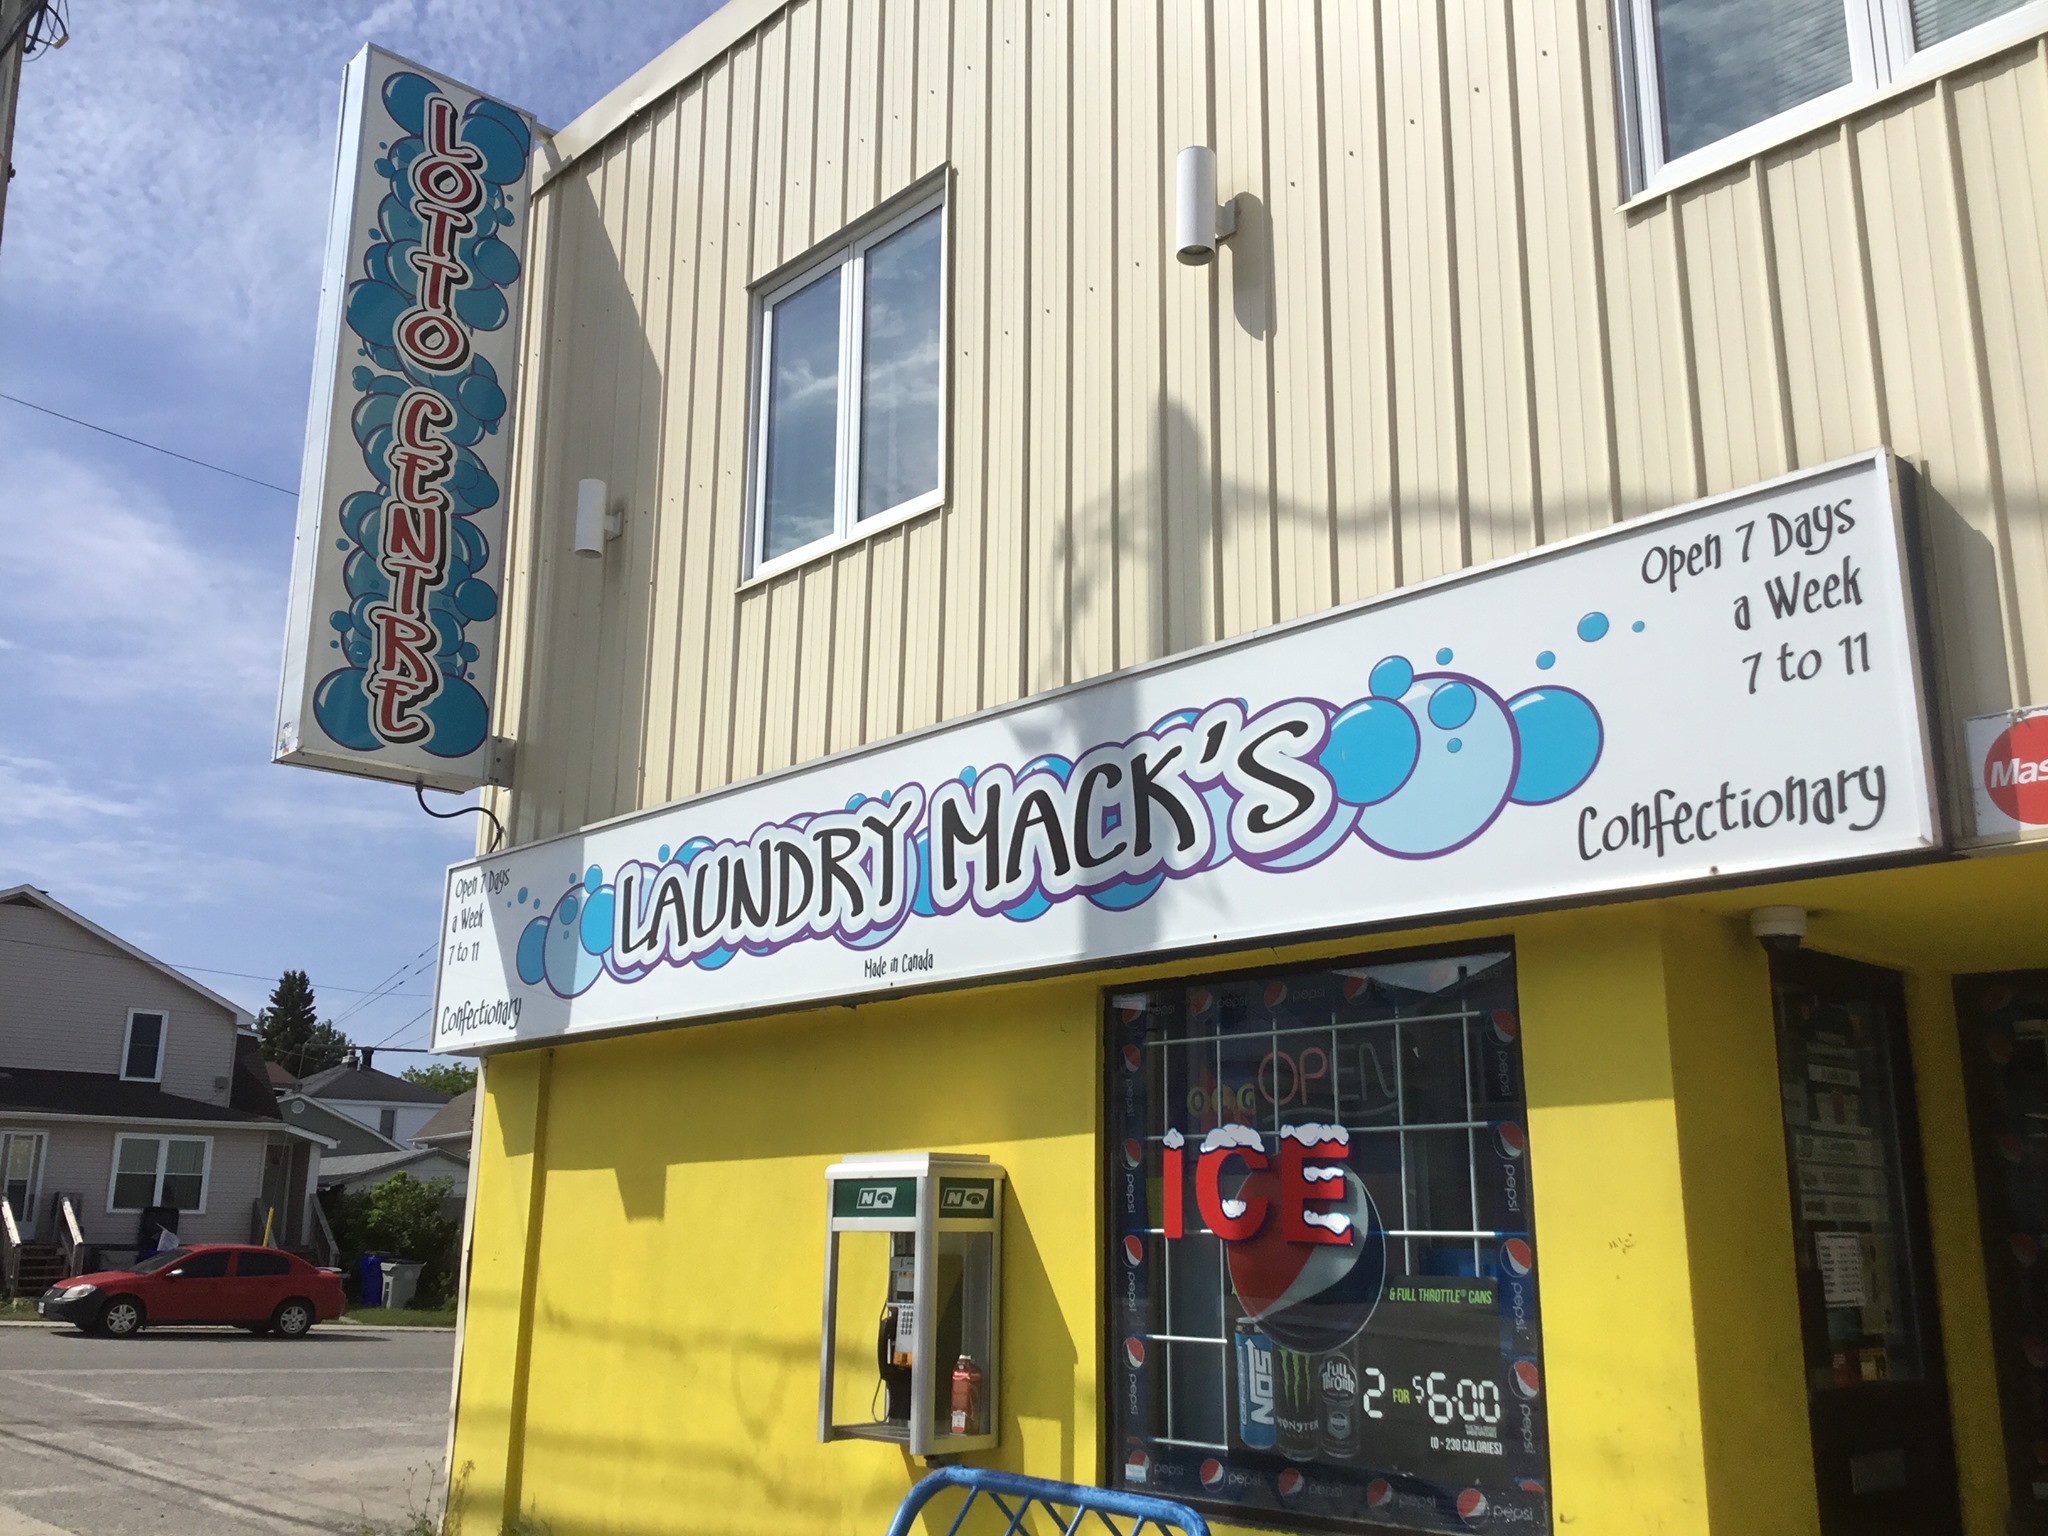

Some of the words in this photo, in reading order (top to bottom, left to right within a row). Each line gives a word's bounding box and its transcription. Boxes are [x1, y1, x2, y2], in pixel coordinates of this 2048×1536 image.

[401, 99, 481, 366] LOTTO
[371, 394, 452, 738] CENTRE
[1641, 533, 1722, 593] Open
[1735, 520, 1756, 563] 7
[1768, 498, 1856, 556] Days
[1734, 596, 1751, 631] a
[1764, 555, 1863, 620] Week
[1742, 652, 1762, 695] 7
[1777, 642, 1822, 683] to
[1838, 632, 1870, 676] 11
[622, 801, 912, 954] LAUNDRY
[942, 720, 1315, 892] MACK'S
[1578, 765, 1886, 861] Confectionary
[455, 876, 477, 903] Open
[480, 873, 487, 893] 7
[488, 868, 510, 895] Days
[452, 916, 457, 933] a
[461, 902, 484, 930] Week
[448, 945, 455, 965] 7
[457, 941, 468, 962] to
[472, 941, 480, 962] 11
[864, 955, 887, 978] Made
[890, 957, 898, 973] in
[902, 948, 933, 973] Canada
[441, 997, 522, 1036] Confectionary
[1257, 1042, 1397, 1106] OPEN
[1497, 1051, 1512, 1096] pepsi
[1126, 1173, 1136, 1214] pepsi
[1163, 1124, 1353, 1244] ICE
[1503, 1163, 1520, 1212] pepsi
[1127, 1271, 1137, 1312] pepsi
[1389, 1288, 1396, 1300] &
[1397, 1287, 1416, 1302] FULL
[1468, 1290, 1492, 1304] CANS
[1511, 1281, 1527, 1333] pepsi
[1128, 1373, 1138, 1416] pepsi
[1363, 1367, 1385, 1419] 2
[1392, 1388, 1410, 1404] FOR
[1445, 1437, 1460, 1451] 230
[1462, 1439, 1503, 1455] CALORIES)
[1520, 1403, 1536, 1454] pepsi
